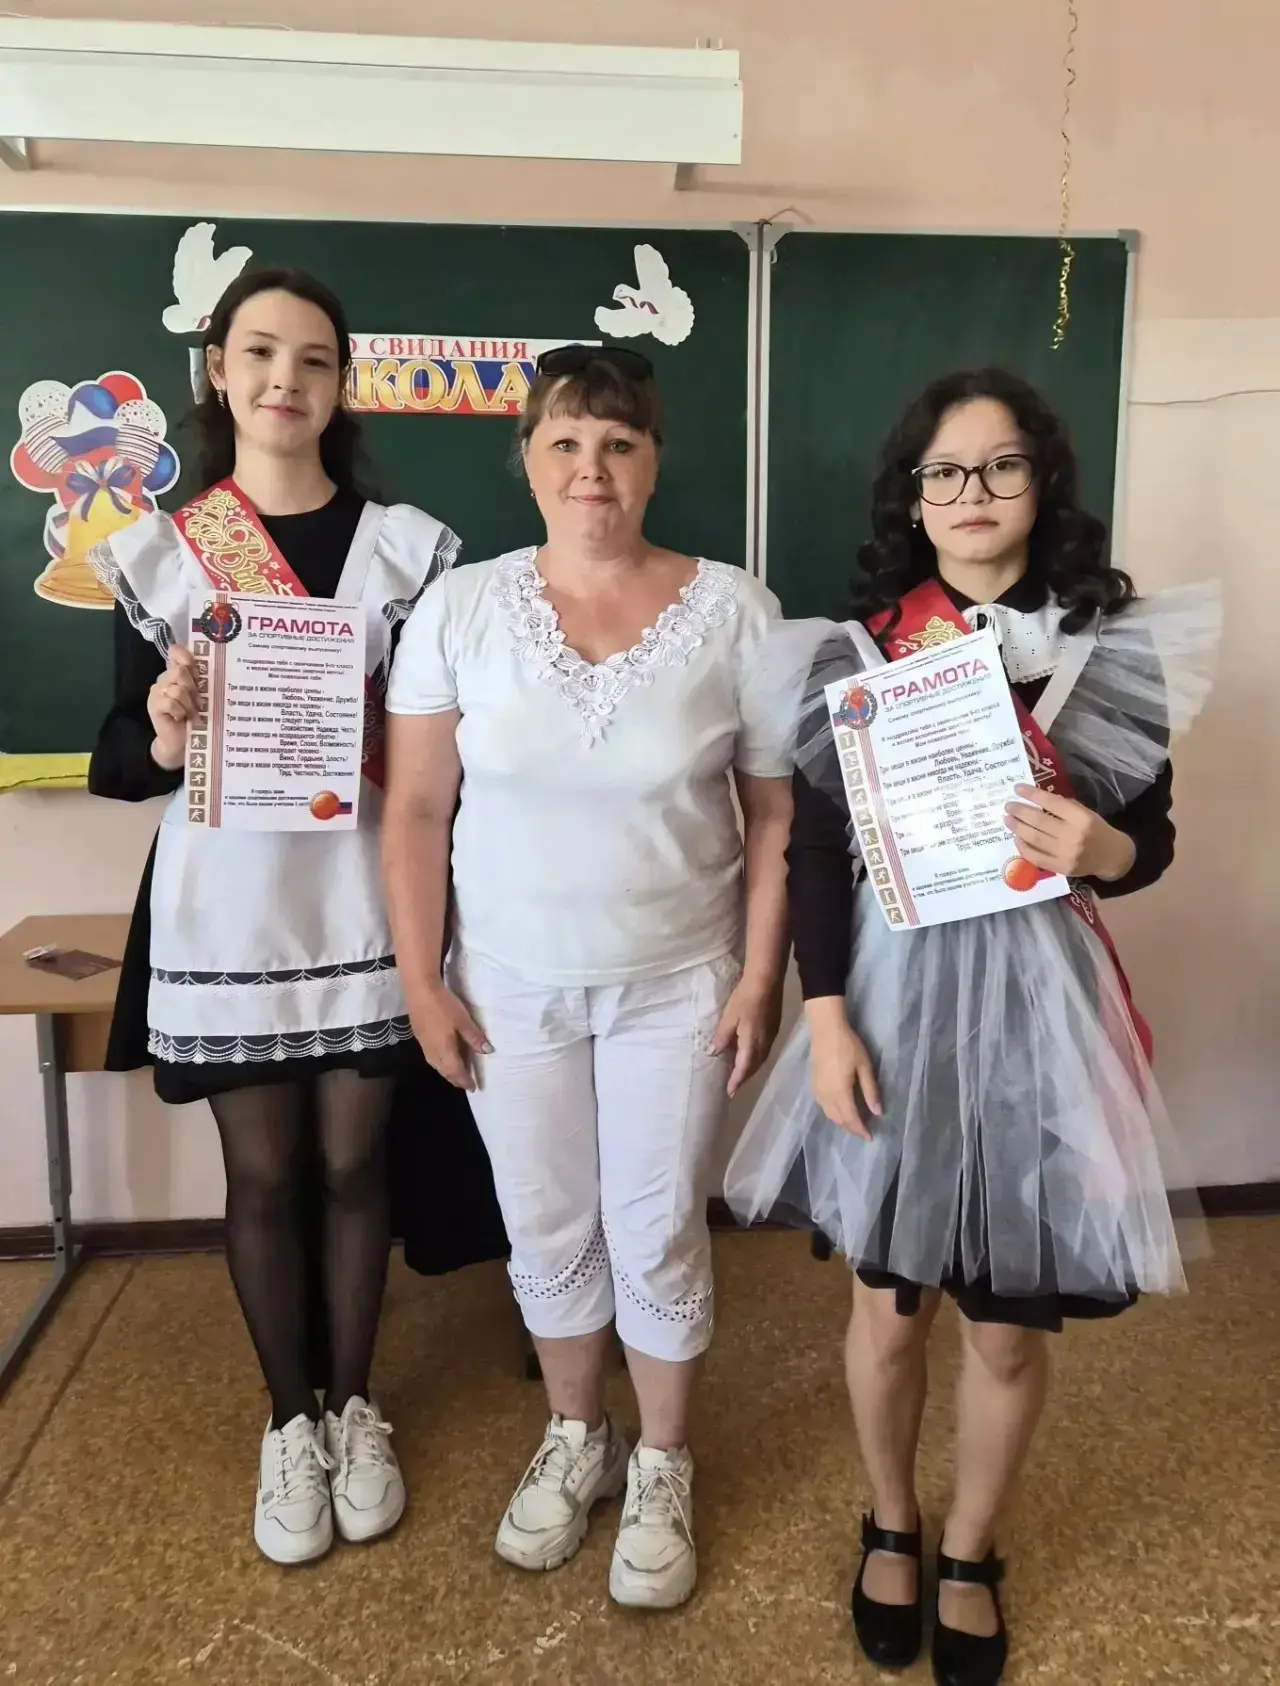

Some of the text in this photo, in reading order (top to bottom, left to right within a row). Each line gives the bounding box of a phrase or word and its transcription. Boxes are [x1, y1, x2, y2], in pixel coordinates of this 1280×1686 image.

[369, 337, 537, 361] СВИДАНИЯ,
[348, 358, 532, 412] КОЛА
[248, 616, 354, 636] ГРАМОТА
[881, 658, 989, 705] ГРАМОТА
[227, 683, 238, 692] Три
[227, 698, 237, 707] Три
[336, 696, 359, 704] Дружба!
[226, 713, 236, 723] Три
[280, 708, 304, 718] Власть,
[325, 710, 358, 719] Состояние!
[226, 729, 236, 738] Три
[225, 744, 235, 753] Три
[299, 739, 319, 748] Слово,
[279, 752, 296, 762] Вино,
[325, 755, 348, 763] Злость!
[225, 760, 235, 769] Три
[937, 772, 963, 784] Власть,
